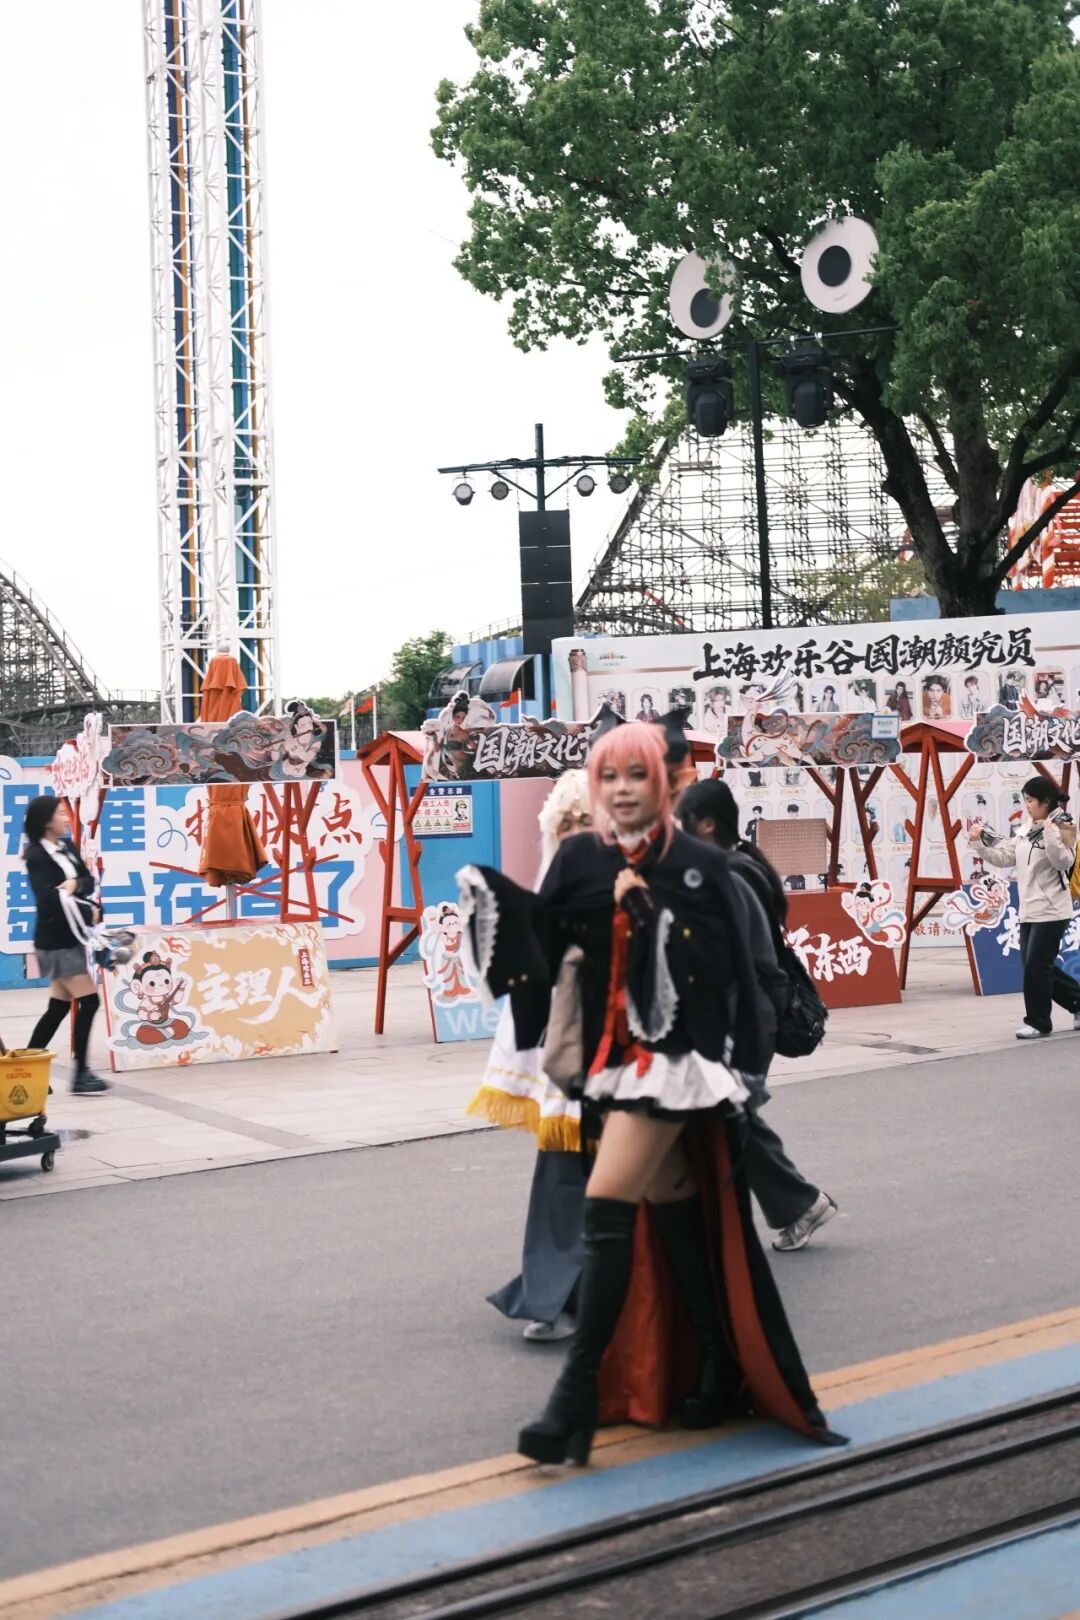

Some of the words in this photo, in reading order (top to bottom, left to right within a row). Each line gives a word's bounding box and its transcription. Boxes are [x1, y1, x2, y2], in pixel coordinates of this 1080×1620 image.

[693, 626, 1037, 682] 上海欢乐谷国潮颜究员
[419, 799, 449, 808] 施工人员
[913, 921, 963, 937] 敬请期
[196, 963, 327, 1025] 主理人
